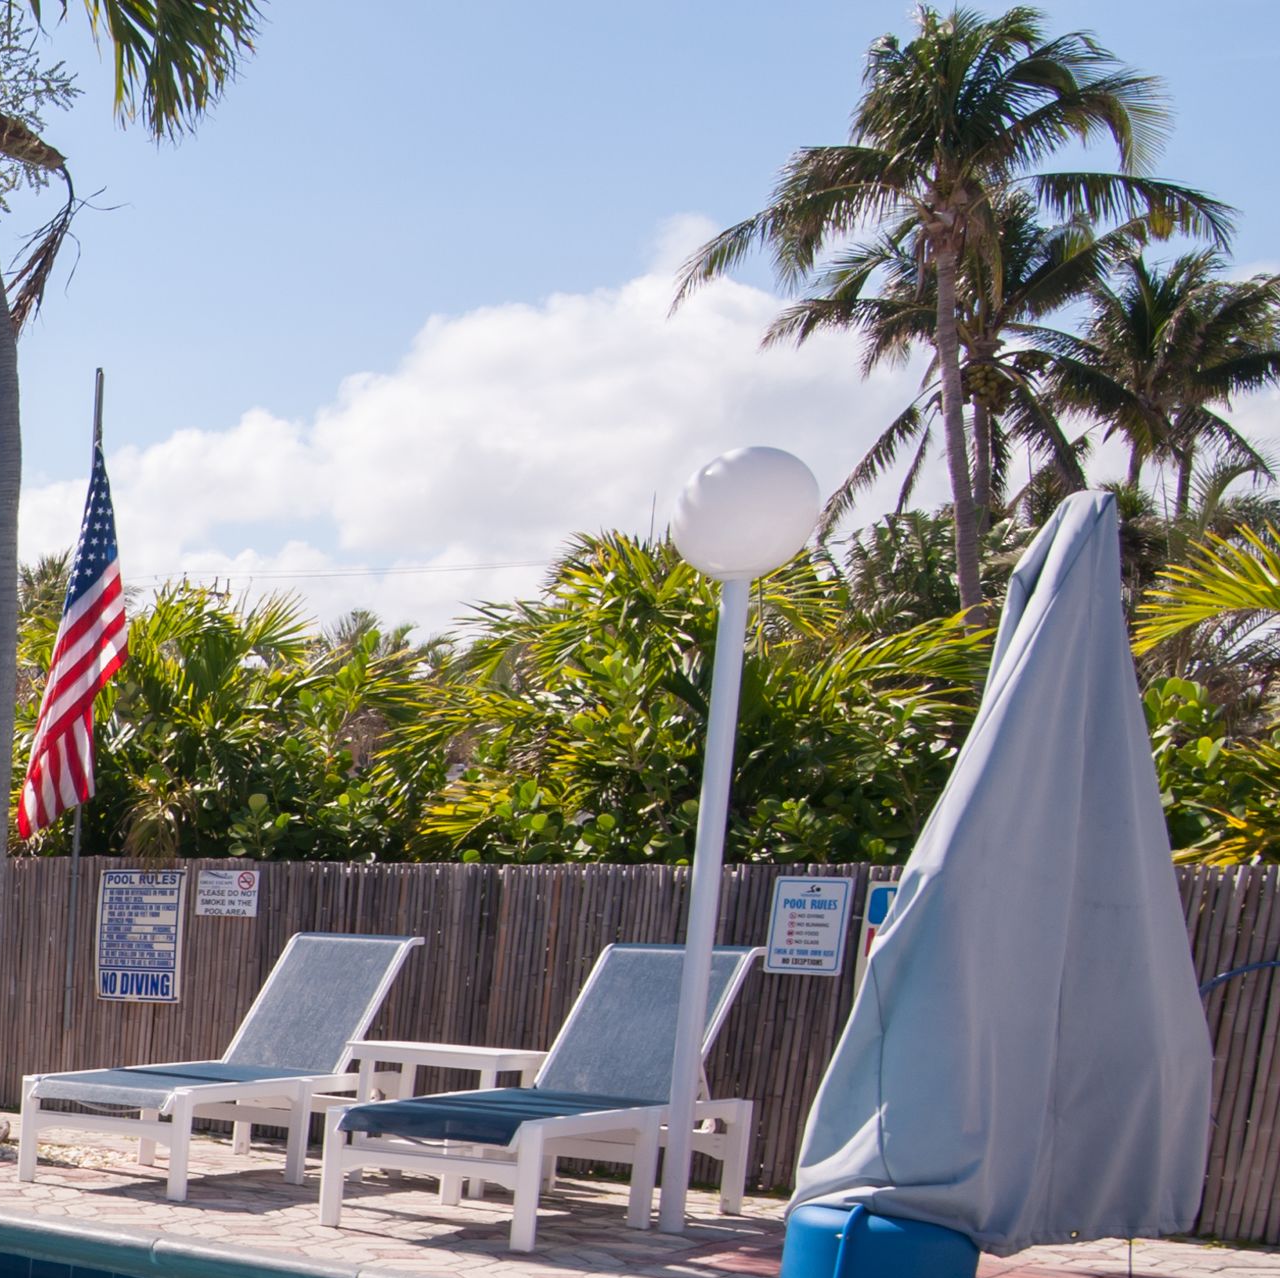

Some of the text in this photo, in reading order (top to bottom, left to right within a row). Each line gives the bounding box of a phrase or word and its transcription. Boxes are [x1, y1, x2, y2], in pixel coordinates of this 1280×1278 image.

[107, 874, 177, 885] POOL RULES
[199, 889, 225, 897] PLEASE
[783, 898, 838, 910] POOL RULES
[102, 971, 170, 997] NO DIVING
